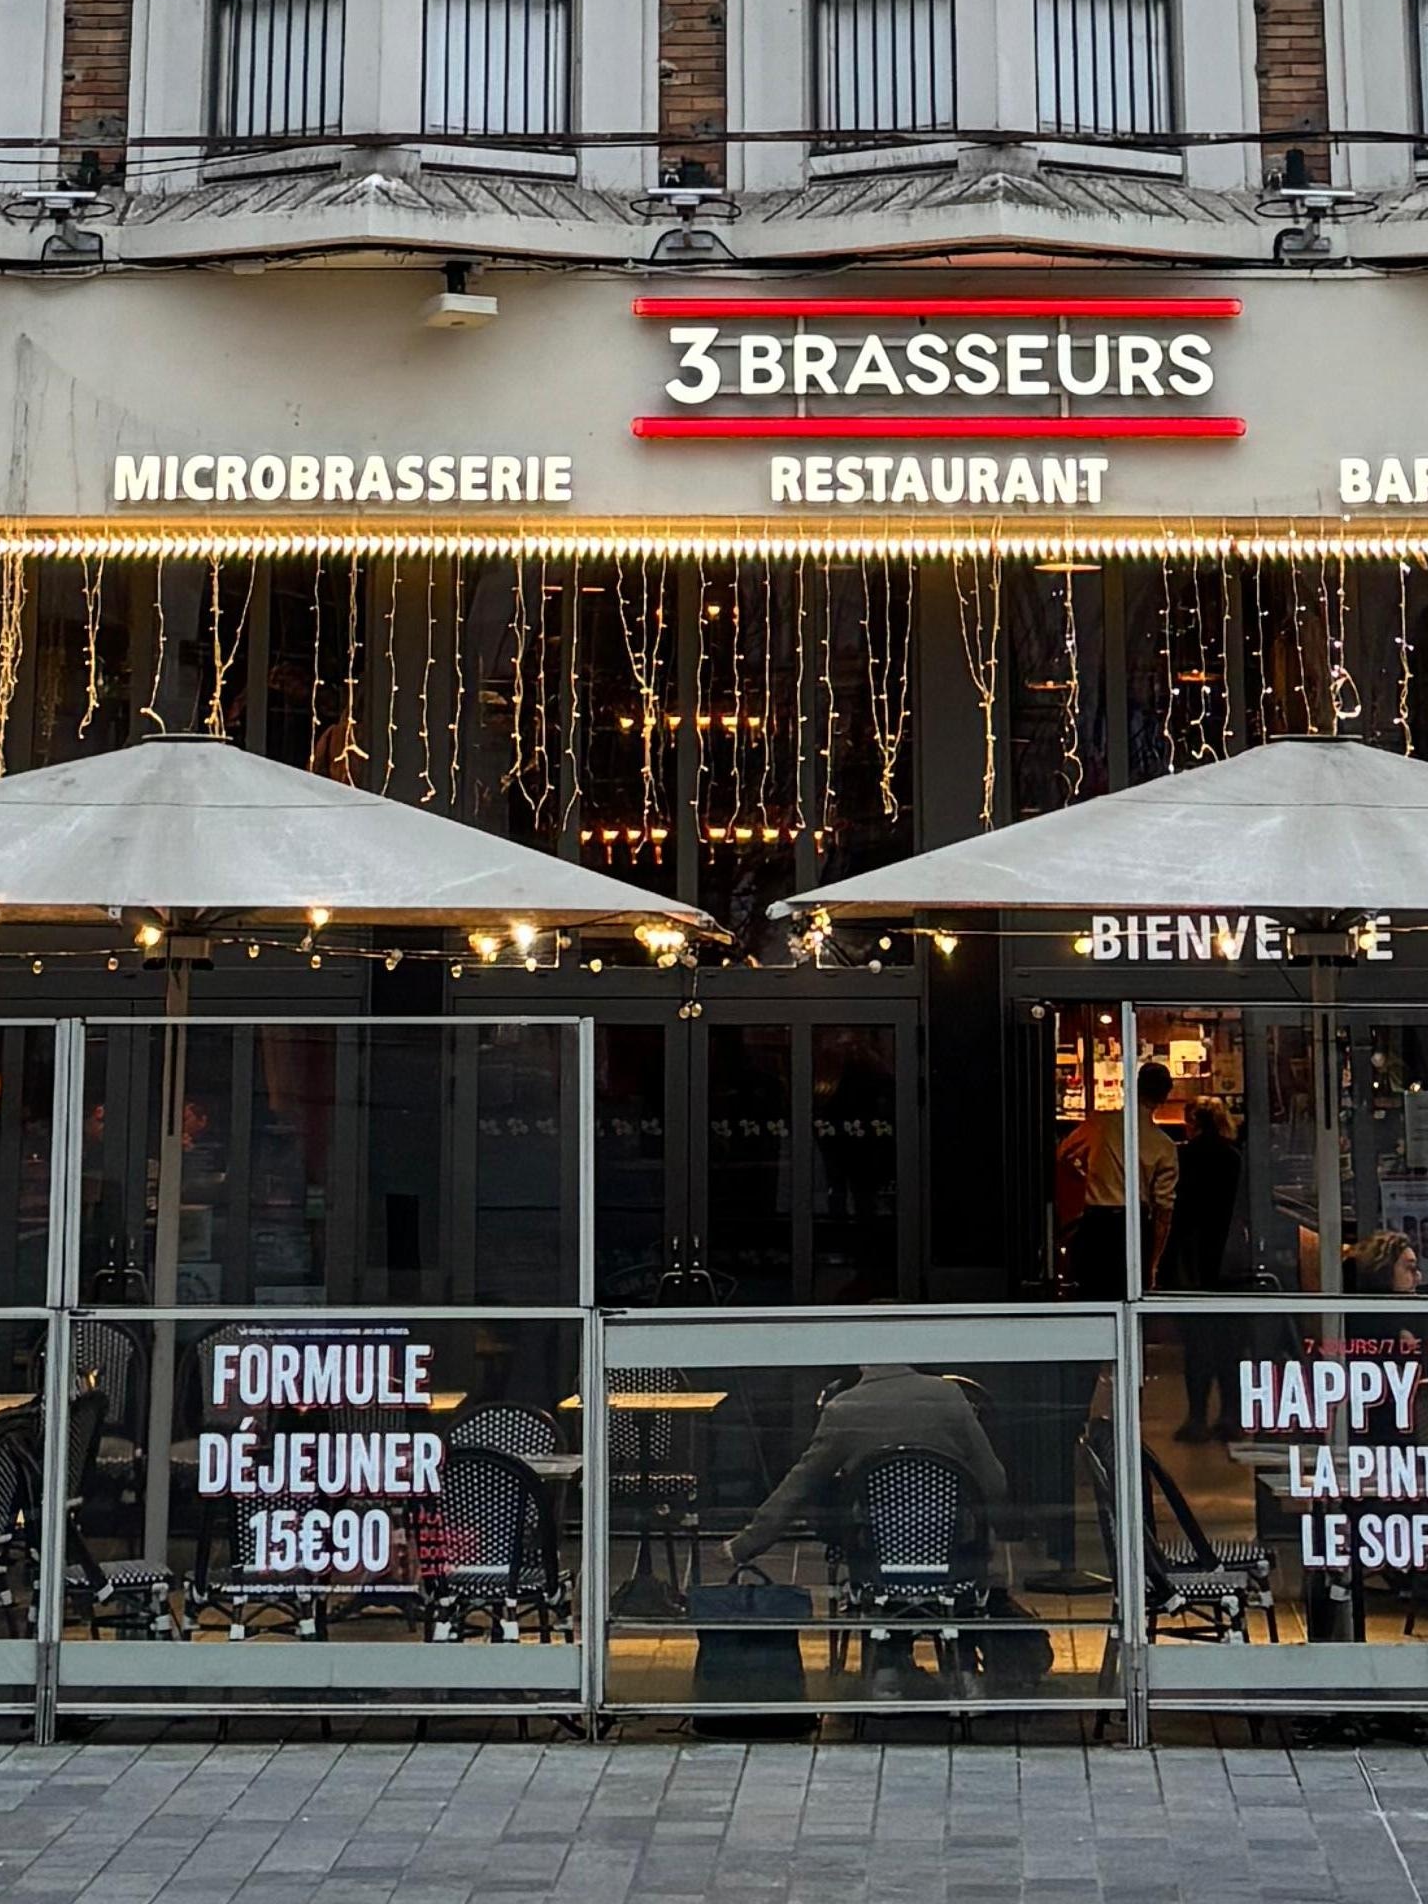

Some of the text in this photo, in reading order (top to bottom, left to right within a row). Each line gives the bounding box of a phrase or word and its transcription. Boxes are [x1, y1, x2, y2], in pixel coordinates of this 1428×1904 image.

[664, 326, 1216, 405] 3 BRASSEURS
[112, 452, 573, 505] MICROBRASSERIE
[770, 454, 1110, 505] RESTAURANT
[1091, 914, 1394, 961] BIENVEE
[212, 1343, 433, 1408] FORMULE
[1238, 1360, 1419, 1431] HAPPY
[197, 1416, 444, 1495] DÉJEUNER
[1288, 1445, 1340, 1499] LA
[248, 1508, 392, 1574] 15€90
[1301, 1514, 1351, 1568] LE
